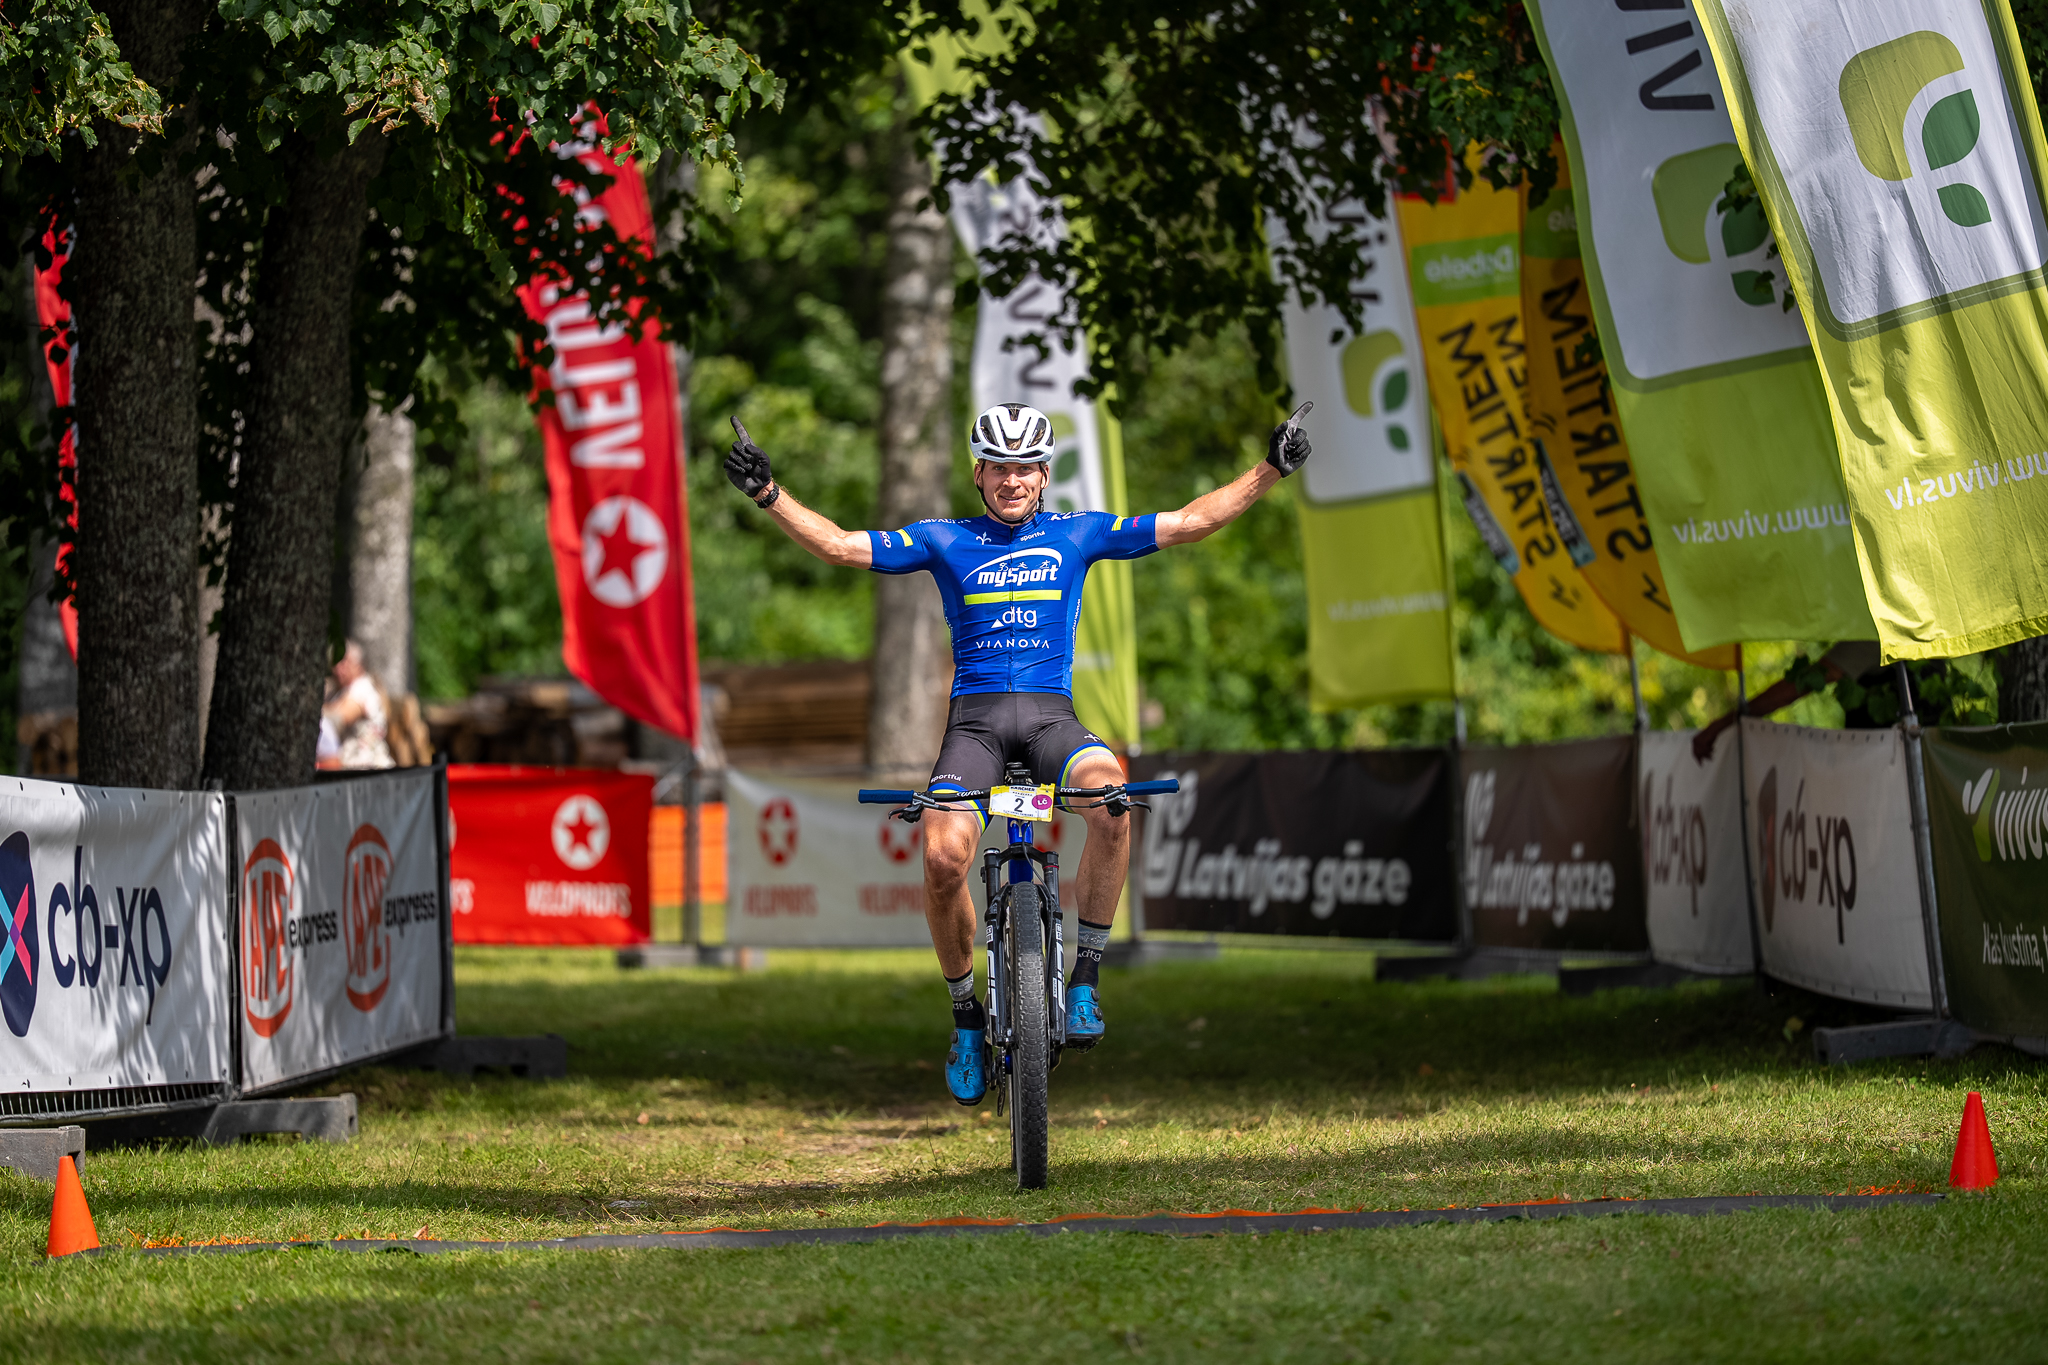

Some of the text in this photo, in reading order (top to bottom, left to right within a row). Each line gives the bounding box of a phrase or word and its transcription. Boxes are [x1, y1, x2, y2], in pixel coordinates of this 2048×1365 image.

[1002, 606, 1038, 628] dtg
[976, 638, 1051, 650] VIANOVA
[1014, 797, 1025, 813] 2
[1780, 776, 1857, 945] cb-xp
[48, 845, 171, 1026] cb-xp
[289, 909, 338, 959] express
[385, 891, 437, 938] express
